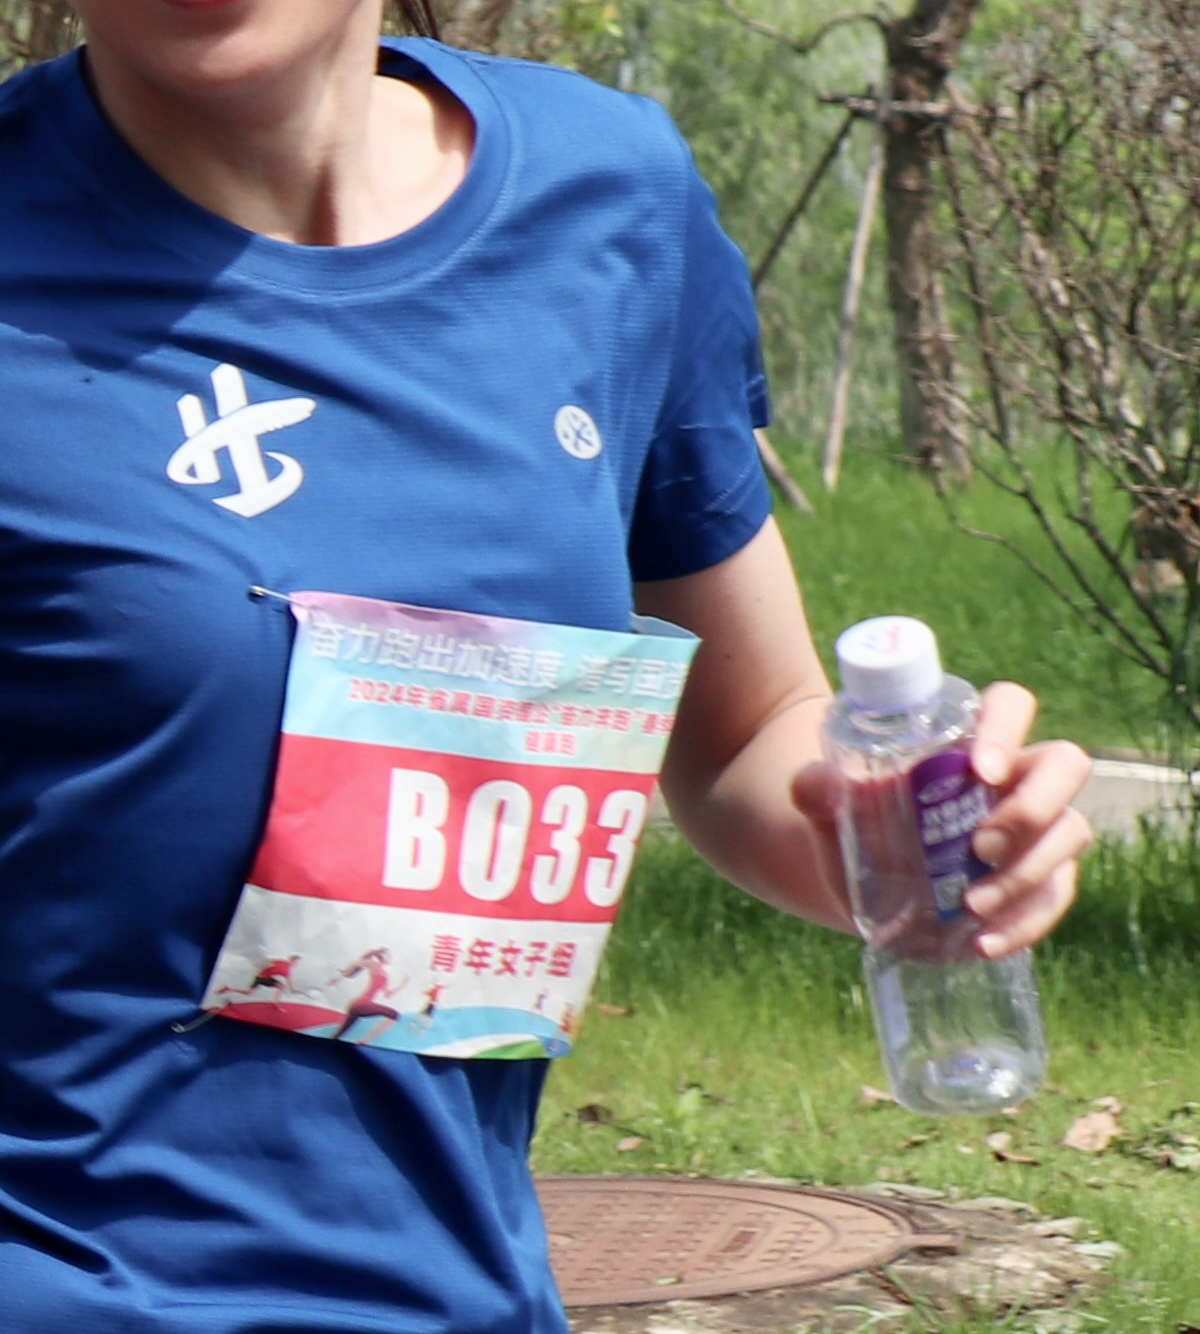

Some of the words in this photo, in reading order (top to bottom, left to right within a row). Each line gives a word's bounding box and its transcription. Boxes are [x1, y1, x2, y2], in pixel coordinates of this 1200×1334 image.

[309, 620, 564, 689] 奋力跑出加速度
[383, 767, 647, 907] B033
[429, 934, 577, 978] 青年女子组
